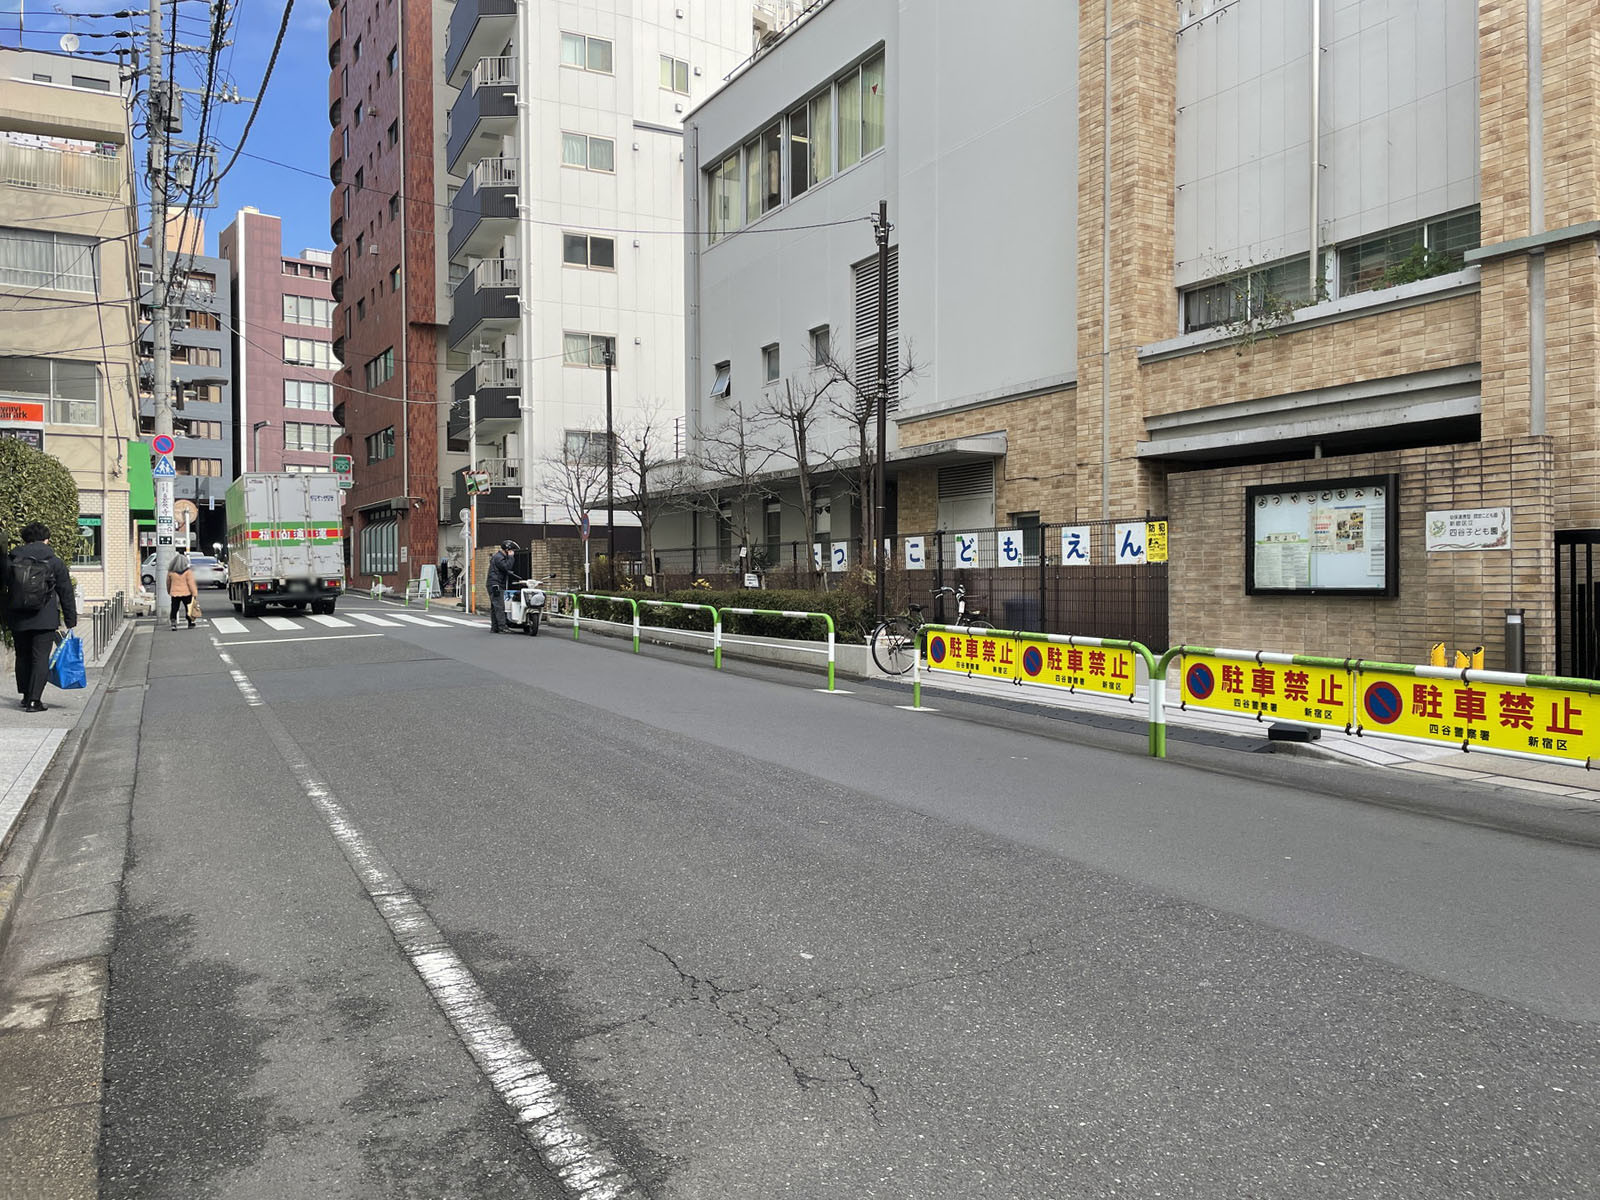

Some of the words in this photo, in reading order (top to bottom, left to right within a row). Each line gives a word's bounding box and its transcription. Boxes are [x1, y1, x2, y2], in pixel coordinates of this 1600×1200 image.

[1257, 488, 1383, 507] よつやこどもえん
[1450, 527, 1498, 537] 四谷子ども園
[949, 636, 1013, 665] 駐車禁止
[1047, 646, 1129, 680] 駐車禁止
[1221, 664, 1344, 707] 駐車禁止
[1233, 698, 1278, 713] 四谷警察署
[1304, 707, 1332, 720] 新宿区
[1411, 683, 1583, 736] 駐車禁止
[1429, 723, 1490, 741] 四谷警察署
[1527, 735, 1568, 751] 新宿区
